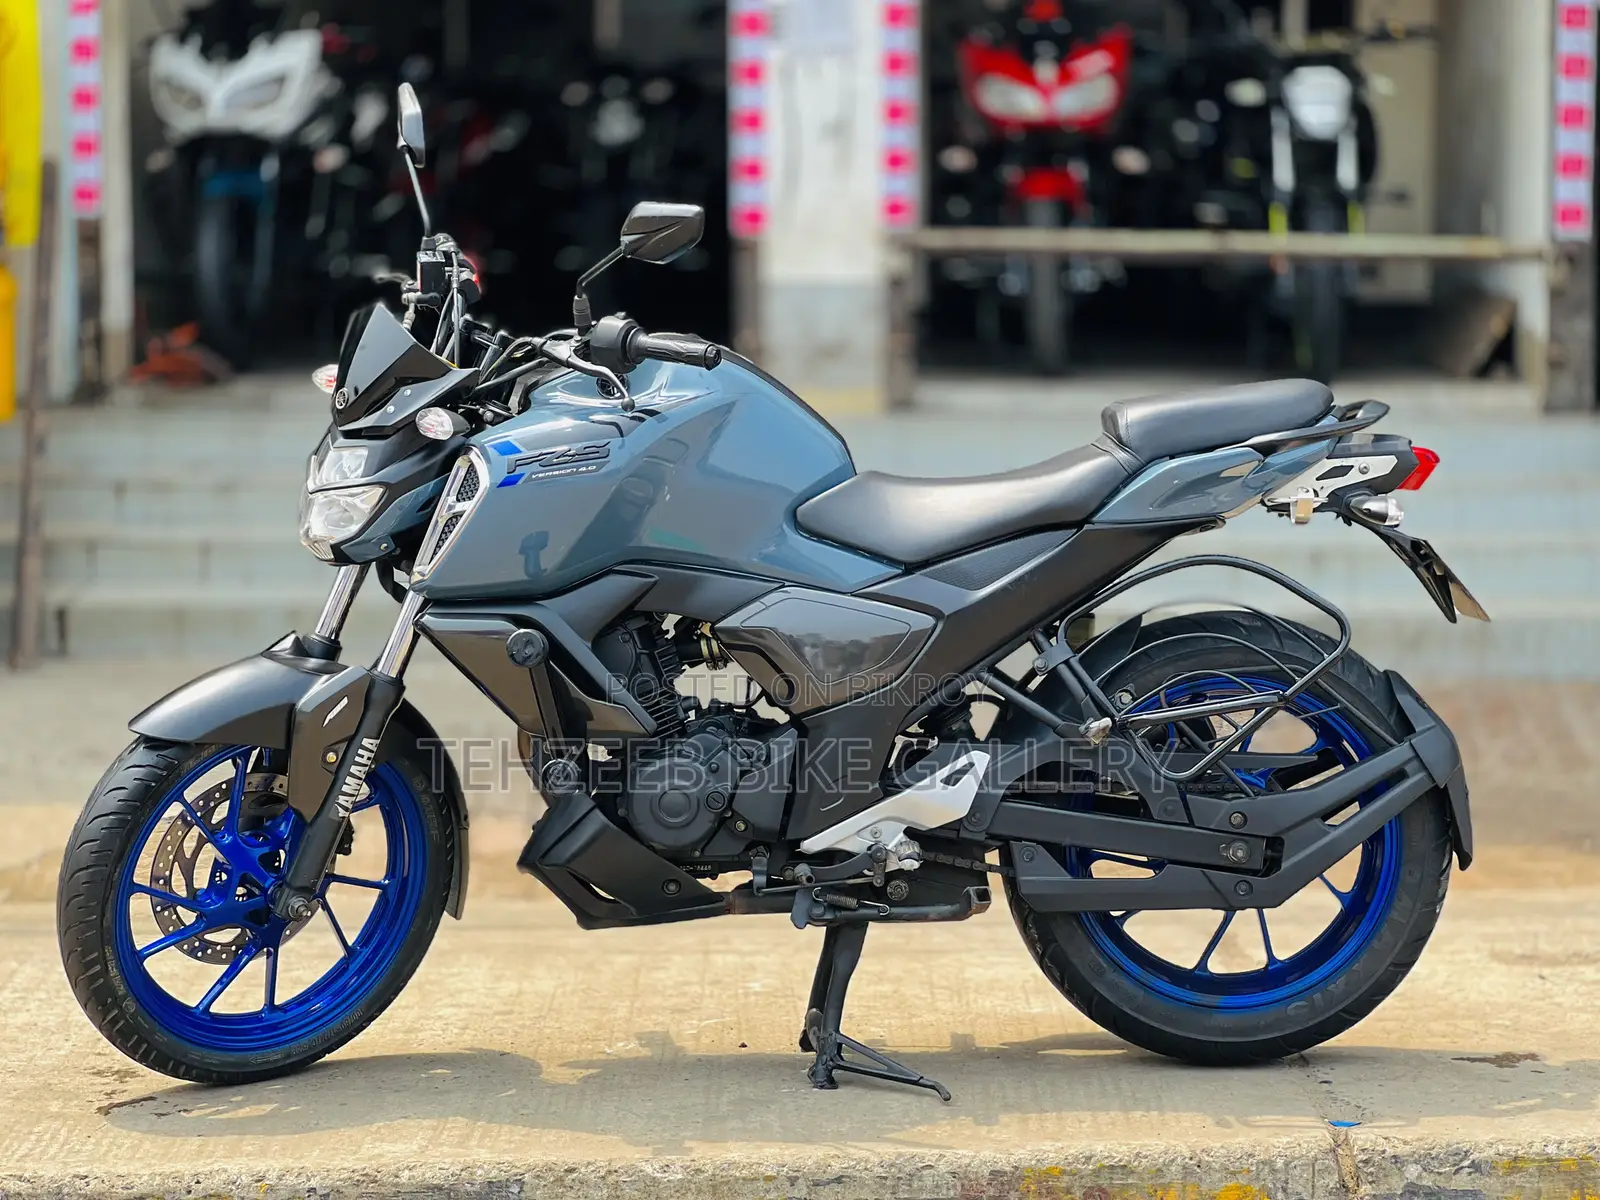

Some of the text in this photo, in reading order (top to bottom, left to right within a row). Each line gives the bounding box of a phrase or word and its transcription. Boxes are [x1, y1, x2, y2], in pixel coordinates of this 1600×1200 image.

[532, 465, 597, 479] VERSION 4.0
[335, 738, 380, 818] YAMAHA
